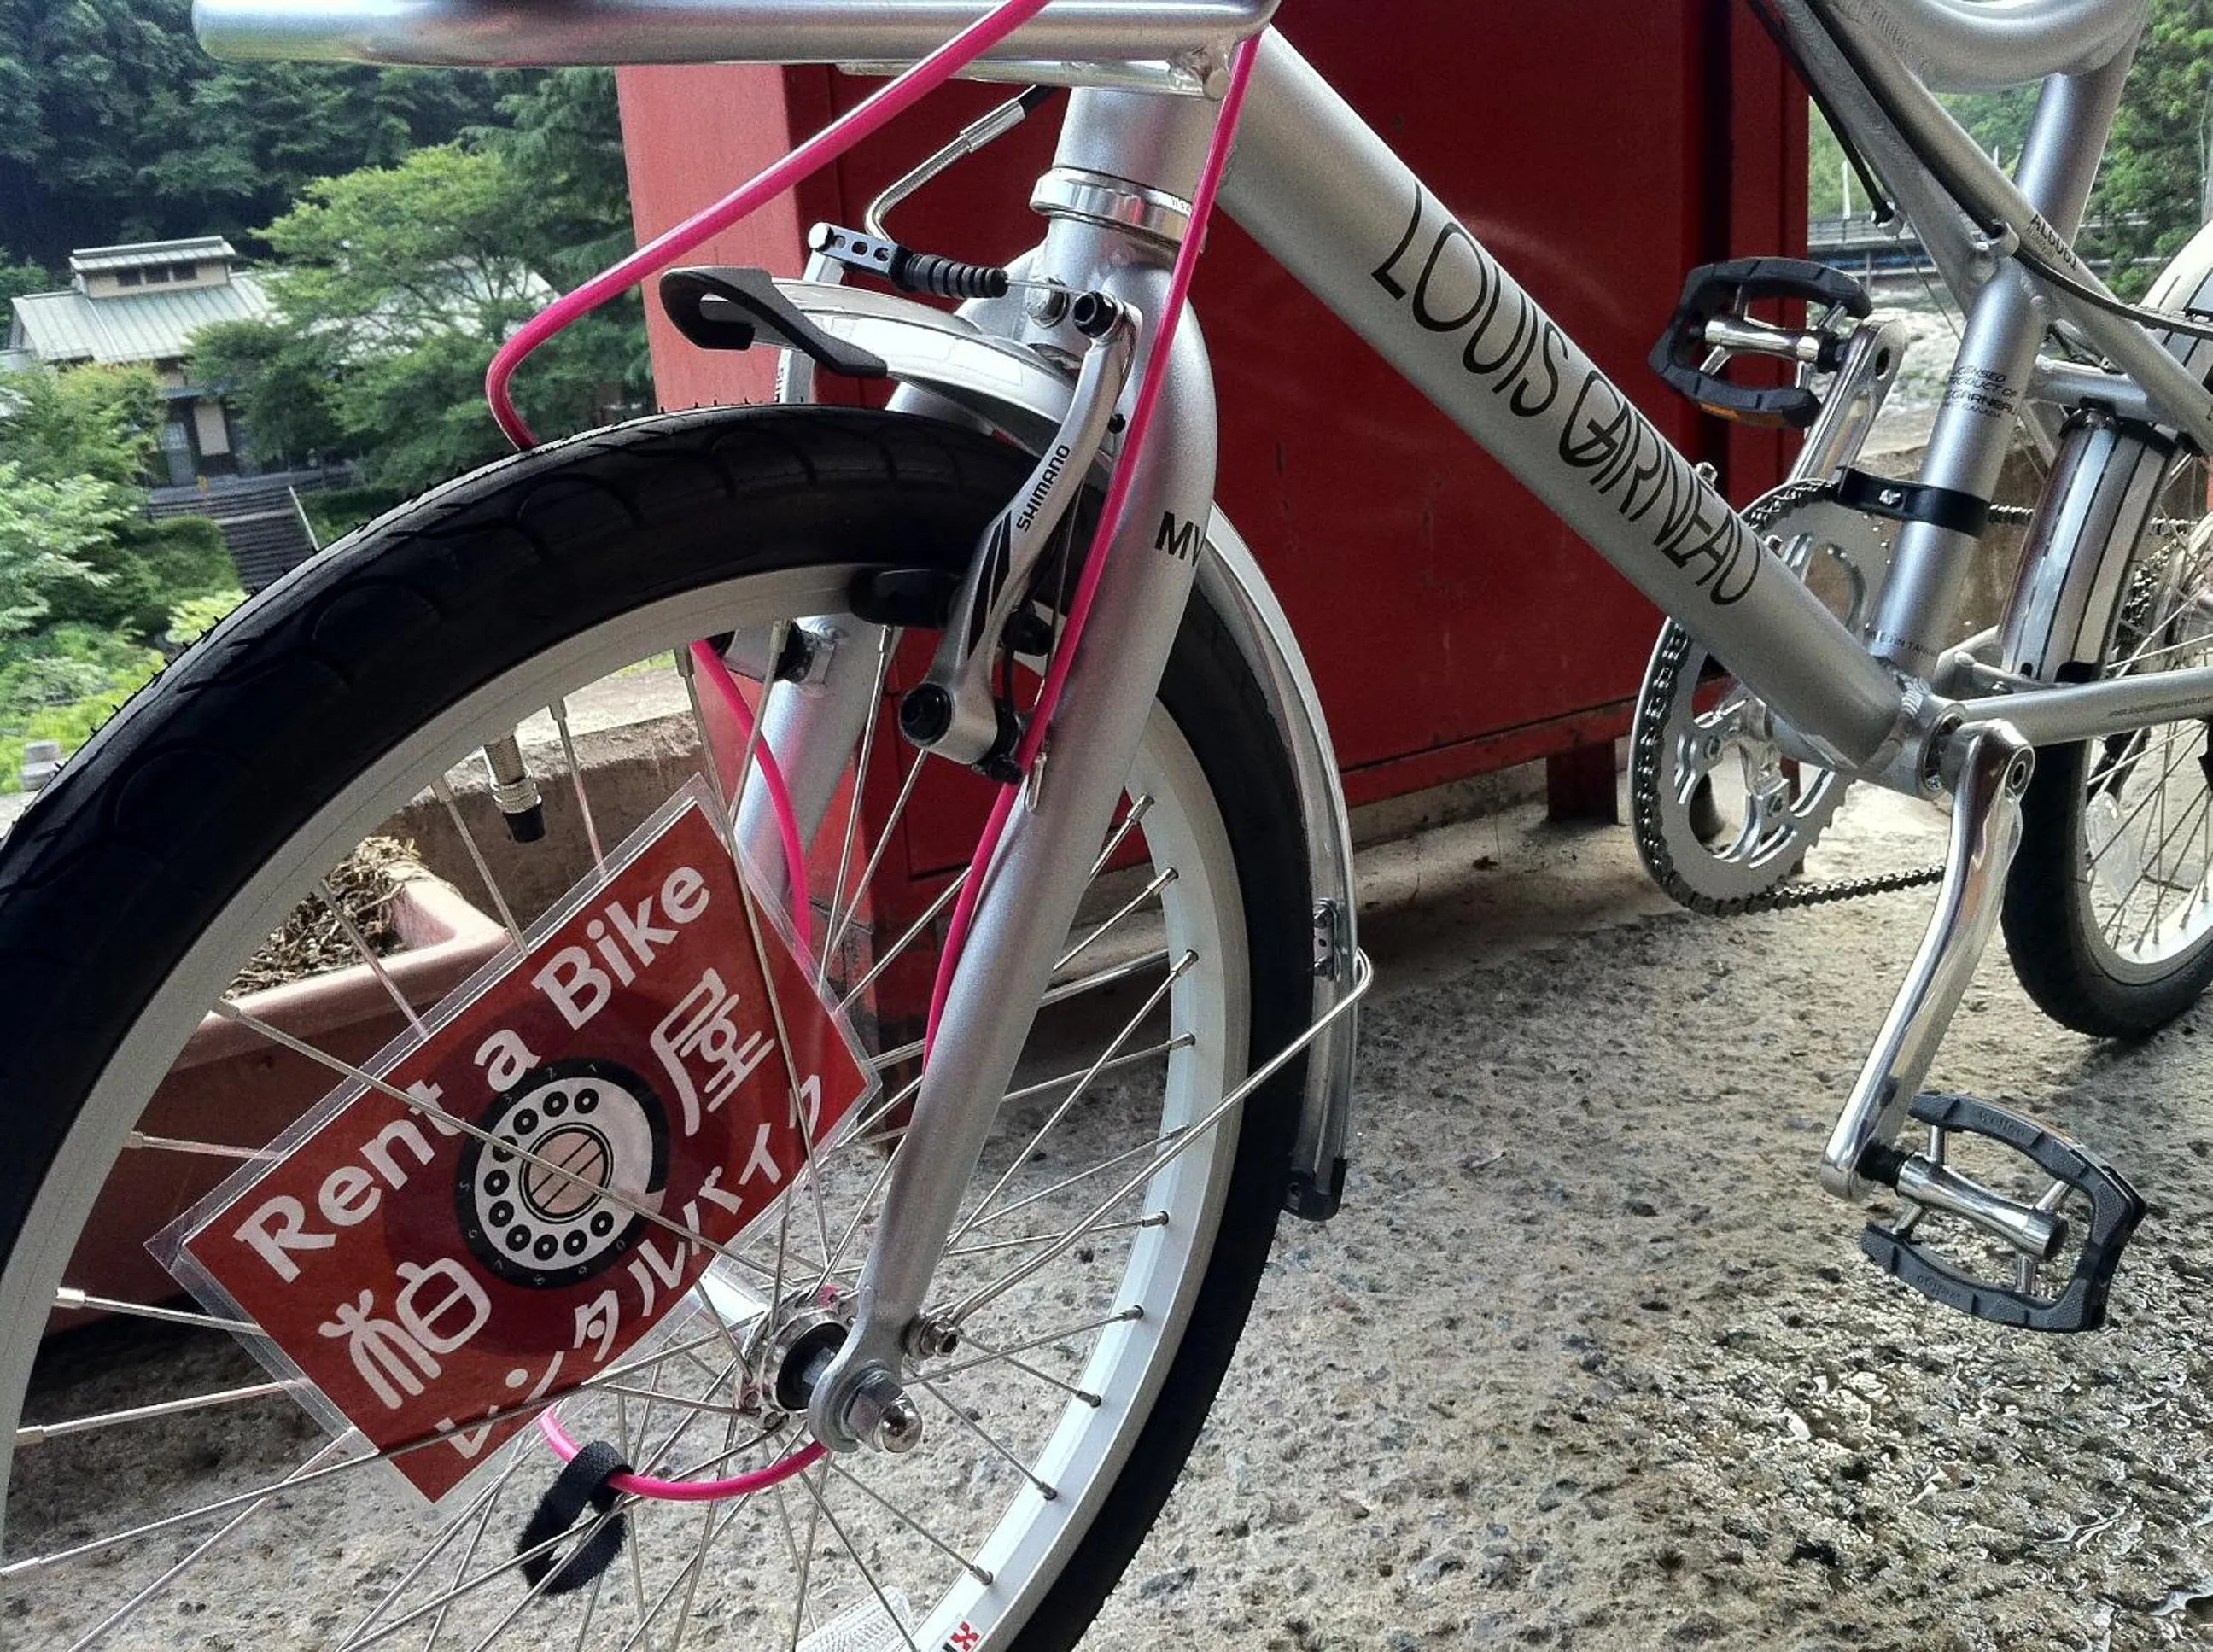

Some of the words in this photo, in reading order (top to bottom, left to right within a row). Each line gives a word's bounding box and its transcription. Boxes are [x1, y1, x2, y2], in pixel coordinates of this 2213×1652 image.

[1016, 444, 1070, 533] SHIMANO
[1370, 182, 1569, 417] LOUIS
[1558, 370, 1760, 605] GARNEAU
[232, 1079, 464, 1283] Rent
[474, 1028, 542, 1092] a
[531, 866, 711, 1031] Bike
[432, 1073, 821, 1459] レンタルバイク
